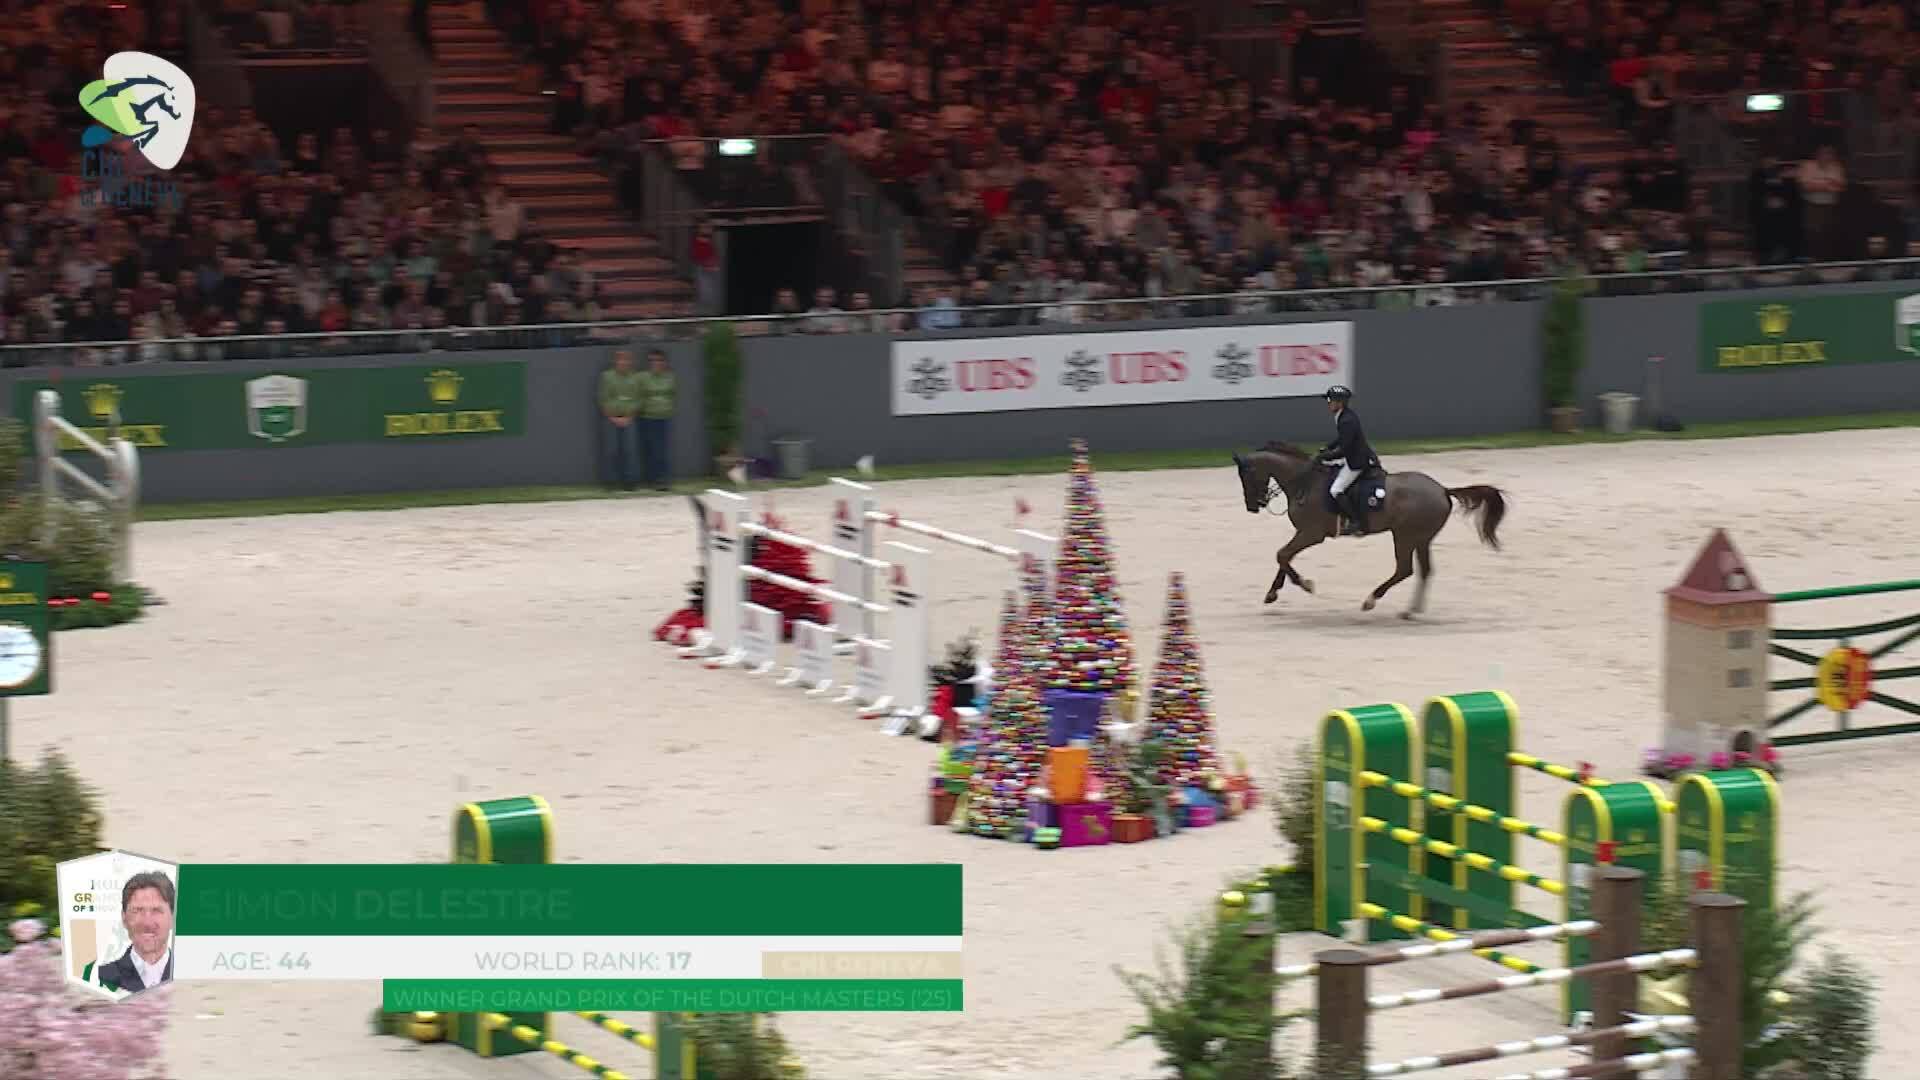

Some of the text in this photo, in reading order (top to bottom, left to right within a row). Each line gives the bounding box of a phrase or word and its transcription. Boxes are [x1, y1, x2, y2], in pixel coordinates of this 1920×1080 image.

[953, 357, 1037, 392] UBS
[1108, 350, 1188, 384] UBS
[1257, 343, 1339, 378] UBS
[385, 409, 504, 438] ROLEX
